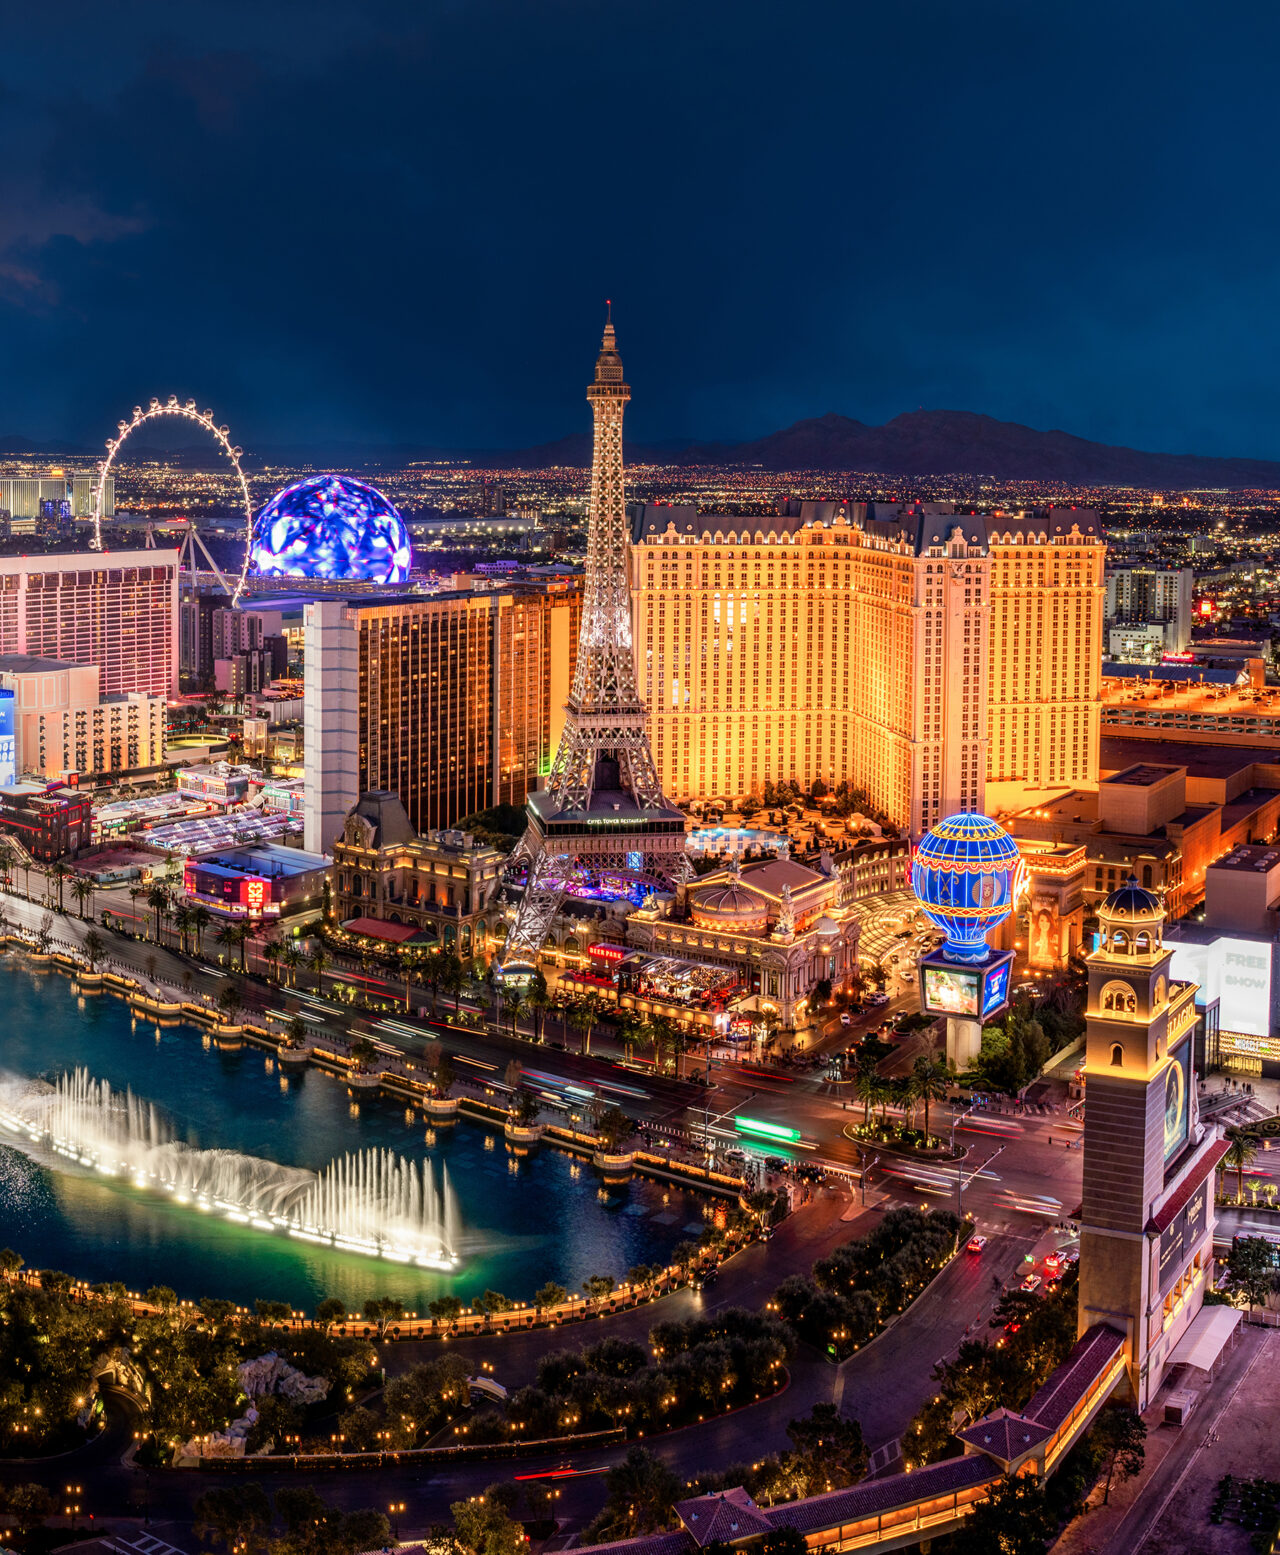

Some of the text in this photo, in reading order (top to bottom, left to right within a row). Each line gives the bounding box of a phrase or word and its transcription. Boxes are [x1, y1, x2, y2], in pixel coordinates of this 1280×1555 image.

[589, 947, 623, 959] BEER PARK
[1225, 952, 1267, 970] FREE
[1225, 974, 1266, 989] SHOW
[1167, 1002, 1195, 1039] LLAGIO
